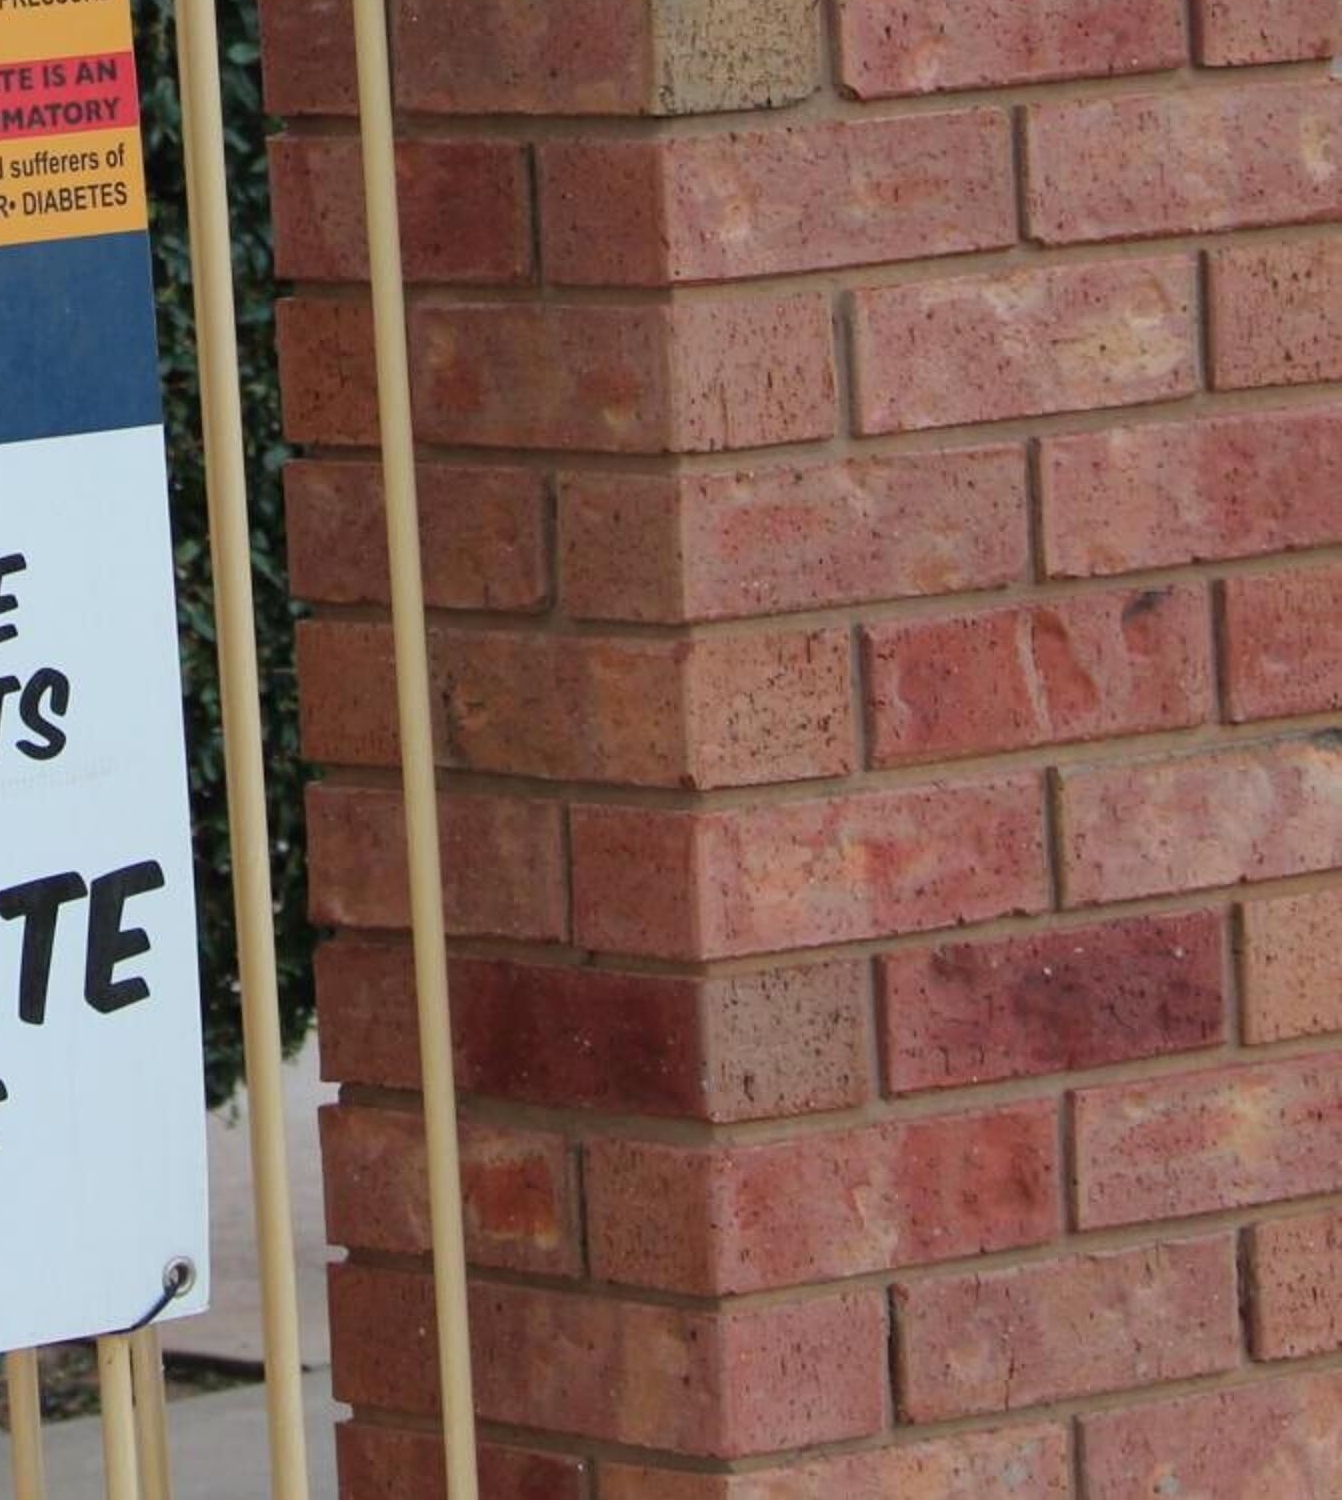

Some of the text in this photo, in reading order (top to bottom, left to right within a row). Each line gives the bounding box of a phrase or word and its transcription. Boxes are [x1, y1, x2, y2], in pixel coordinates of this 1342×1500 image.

[42, 63, 66, 87] IS
[75, 58, 118, 85] AN
[10, 146, 100, 180] sufferers
[106, 142, 126, 169] of
[23, 181, 128, 216] DIABETES
